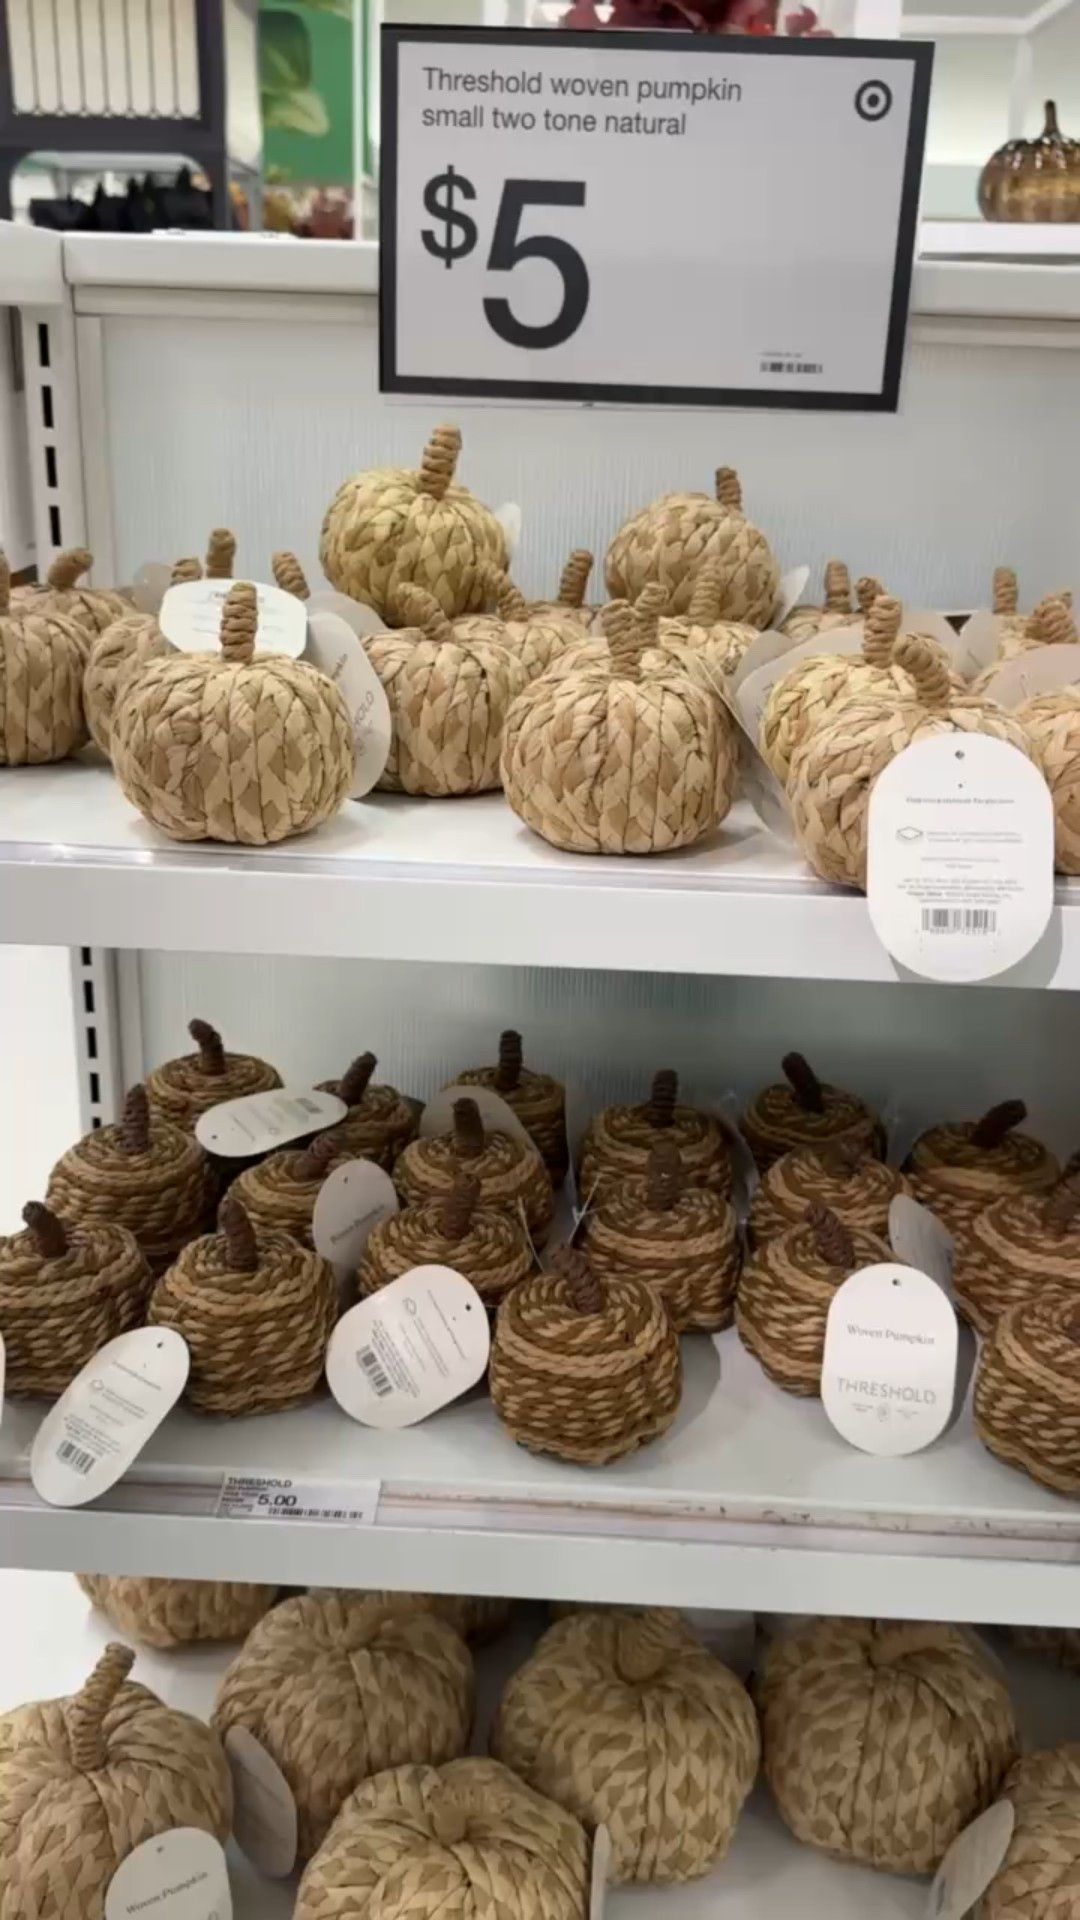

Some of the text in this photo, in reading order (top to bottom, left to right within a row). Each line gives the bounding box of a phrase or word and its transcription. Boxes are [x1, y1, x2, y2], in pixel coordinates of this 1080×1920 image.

[422, 67, 742, 105] Threshold woven pumpkin
[422, 105, 687, 136] small two tone natural
[420, 164, 590, 350] $5
[847, 1324, 936, 1345] Woven Pumpkin
[837, 1376, 937, 1405] THRESHOLD
[228, 1477, 292, 1488] THRESHOLD
[257, 1494, 297, 1506] 5.00
